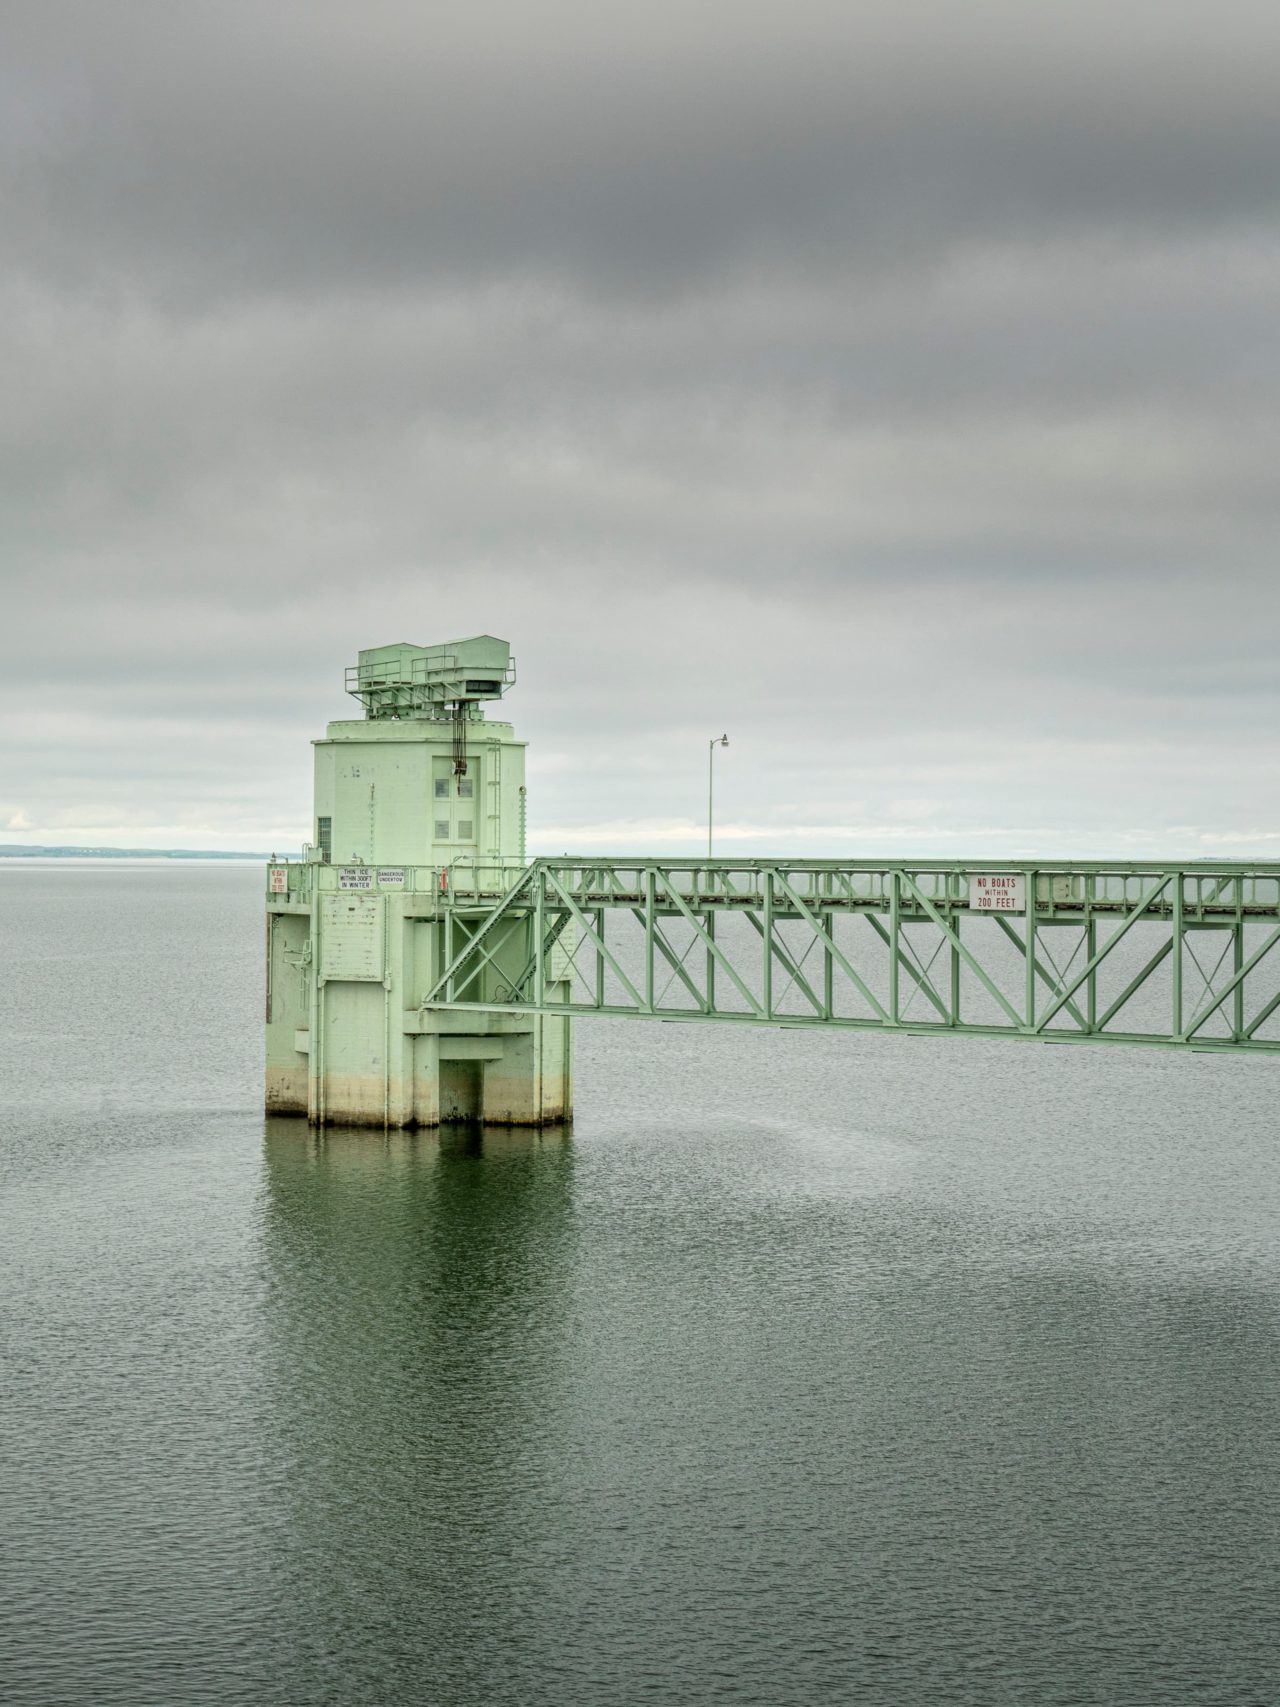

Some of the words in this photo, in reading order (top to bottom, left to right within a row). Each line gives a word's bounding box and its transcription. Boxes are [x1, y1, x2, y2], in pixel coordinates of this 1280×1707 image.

[978, 878, 986, 887] NO
[992, 878, 1016, 888] BOATS
[978, 898, 992, 907] 200
[996, 898, 1016, 908] FEET
